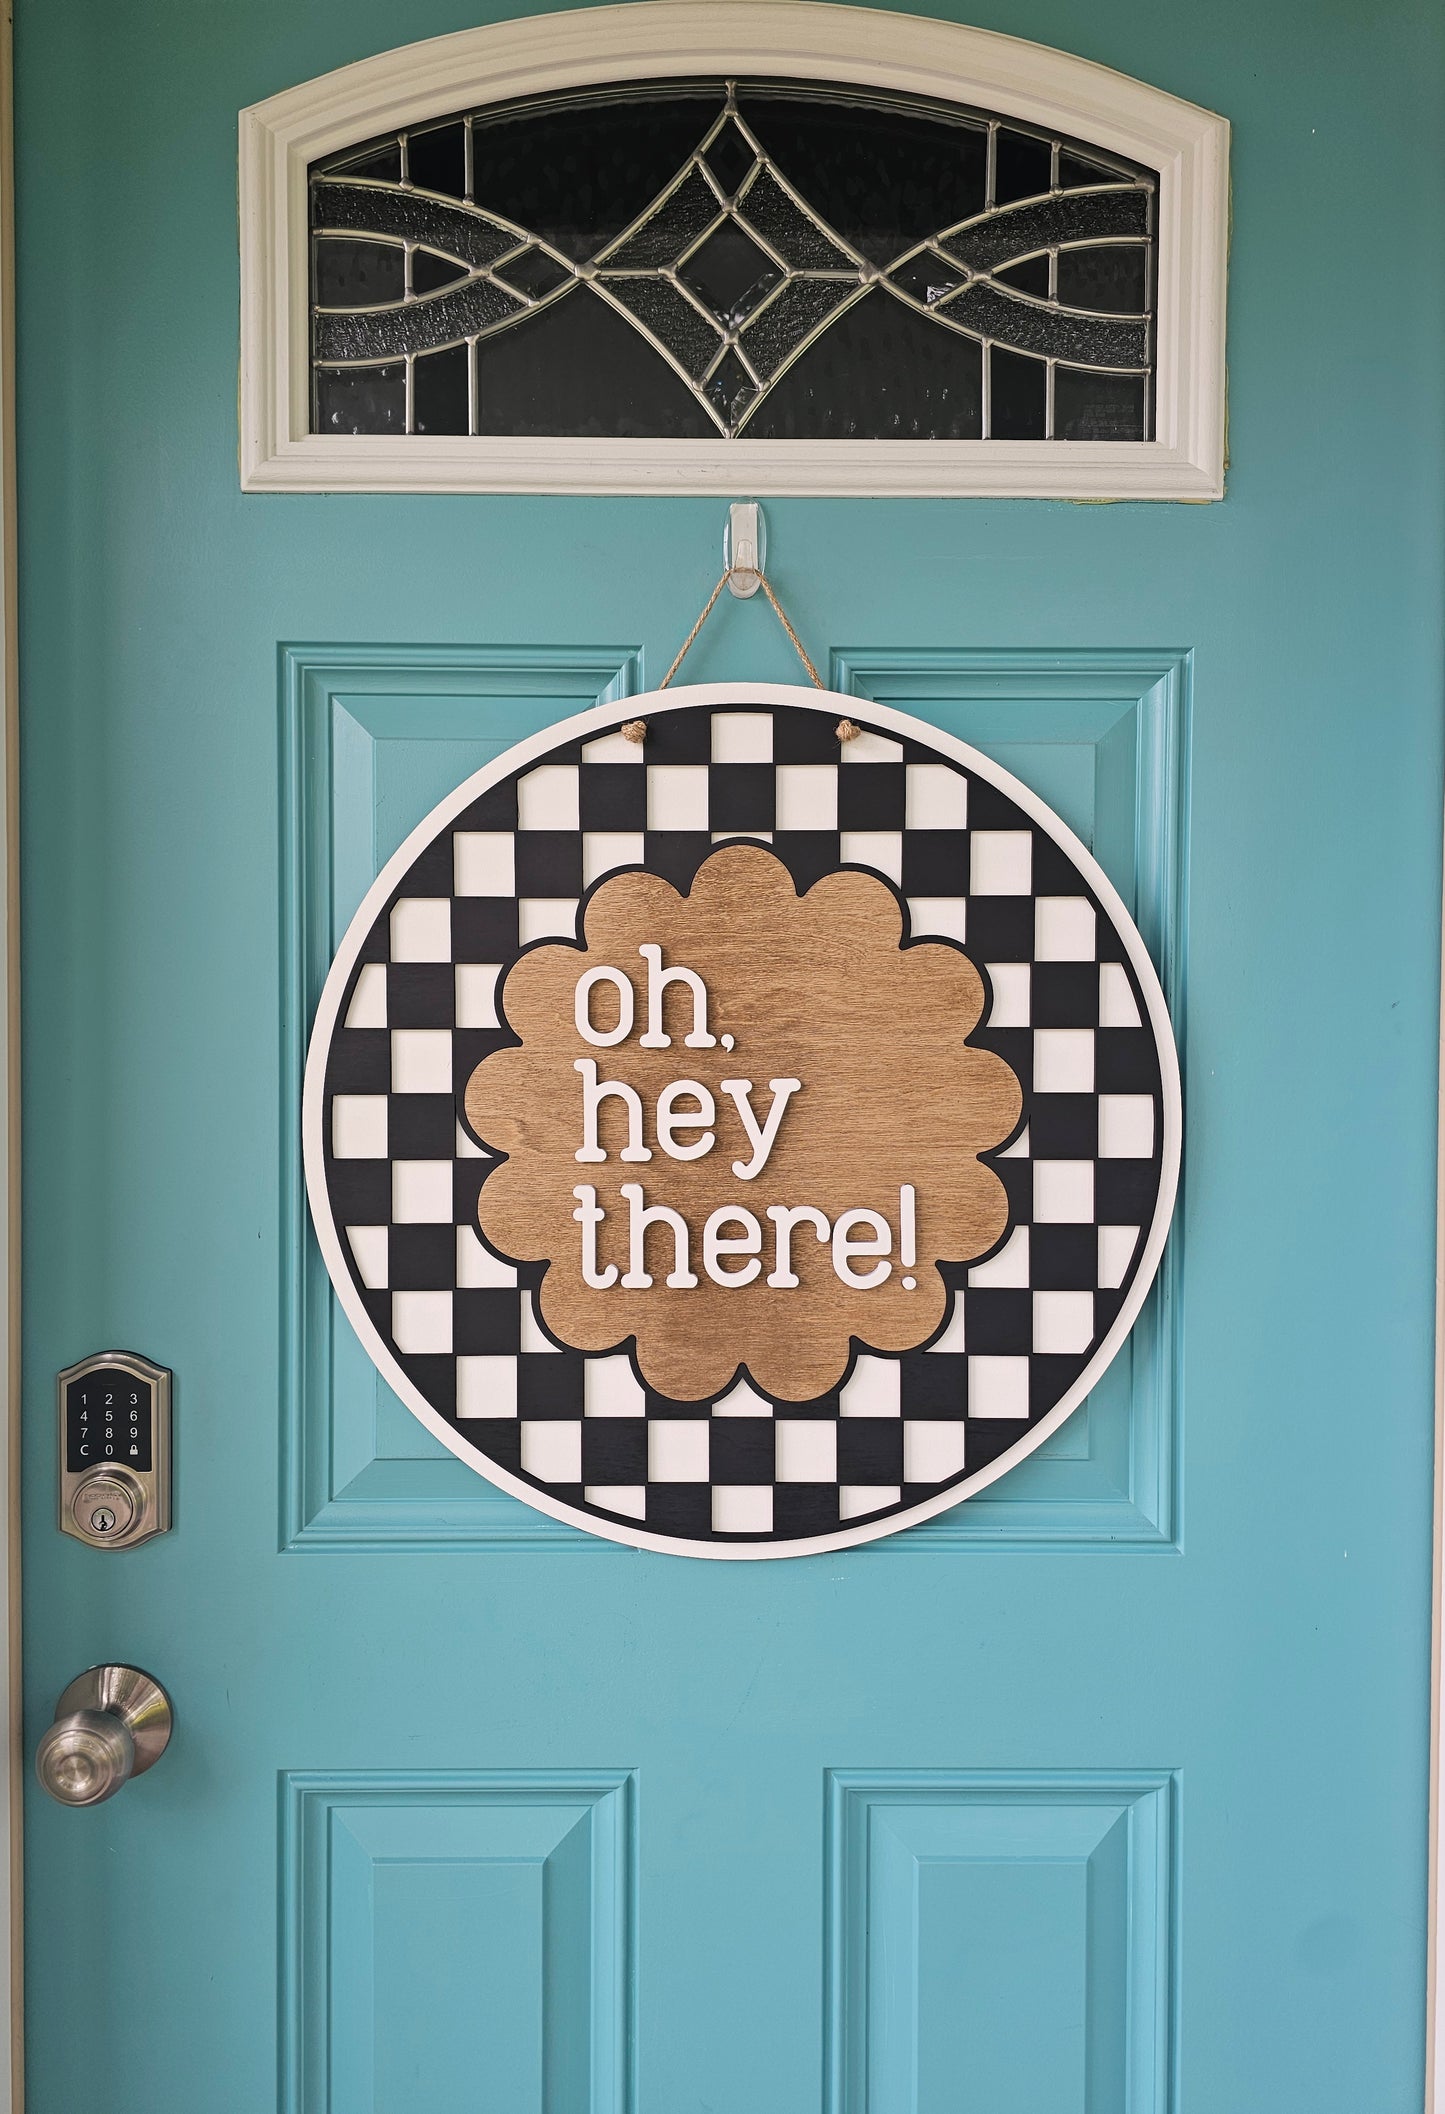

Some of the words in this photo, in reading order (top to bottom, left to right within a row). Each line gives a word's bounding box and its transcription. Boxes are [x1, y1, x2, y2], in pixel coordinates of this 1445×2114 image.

[574, 943, 735, 1052] oh,
[573, 1058, 802, 1180] hey
[572, 1184, 916, 1290] there!
[81, 1393, 87, 1405] 1
[104, 1393, 113, 1405] 2
[129, 1393, 138, 1405] 3
[80, 1410, 88, 1422] 4
[105, 1410, 113, 1422] 5
[129, 1410, 138, 1422] 6
[80, 1427, 88, 1439] 7
[105, 1427, 114, 1439] 8
[129, 1427, 138, 1439] 9
[80, 1444, 89, 1456] C
[105, 1444, 114, 1456] 0
